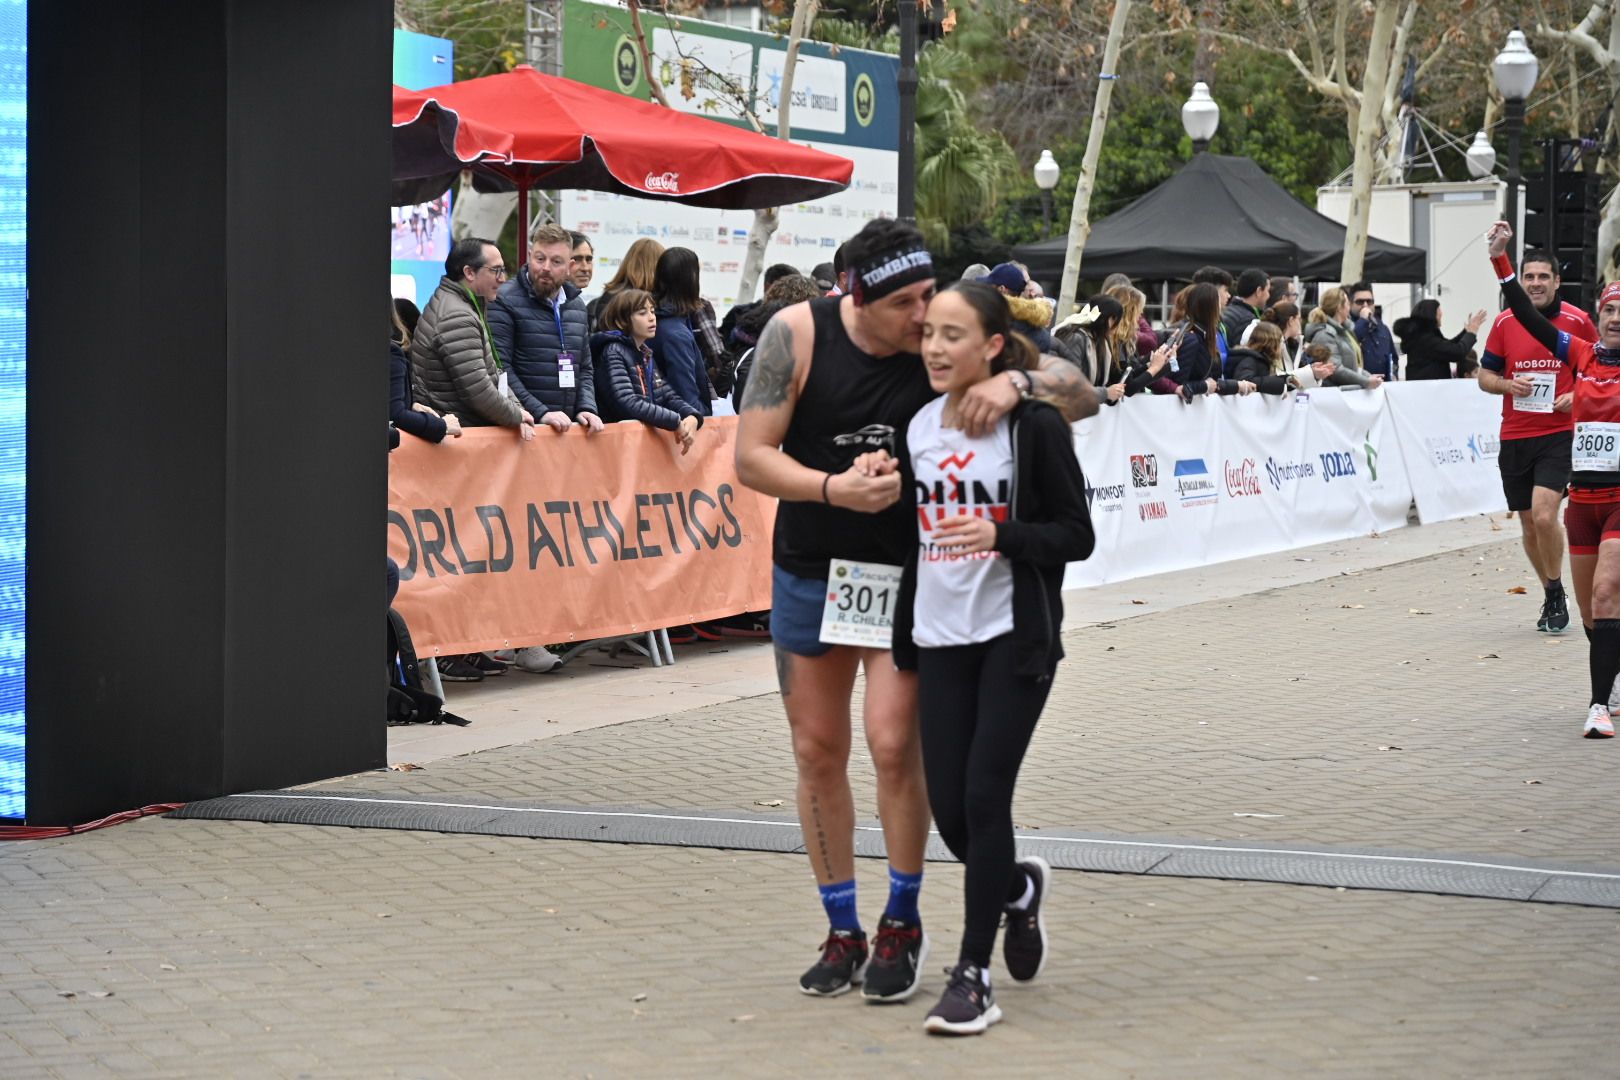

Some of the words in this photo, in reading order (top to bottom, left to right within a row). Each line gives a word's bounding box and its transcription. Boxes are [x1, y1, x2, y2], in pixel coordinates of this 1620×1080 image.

[1515, 359, 1562, 369] MOBOTIX
[1532, 384, 1550, 398] 77
[1576, 434, 1615, 452] 3608
[1143, 501, 1168, 520] YAMAHA
[387, 504, 514, 581] ORLD
[527, 483, 742, 570] ATHLETICS
[836, 583, 889, 616] 301
